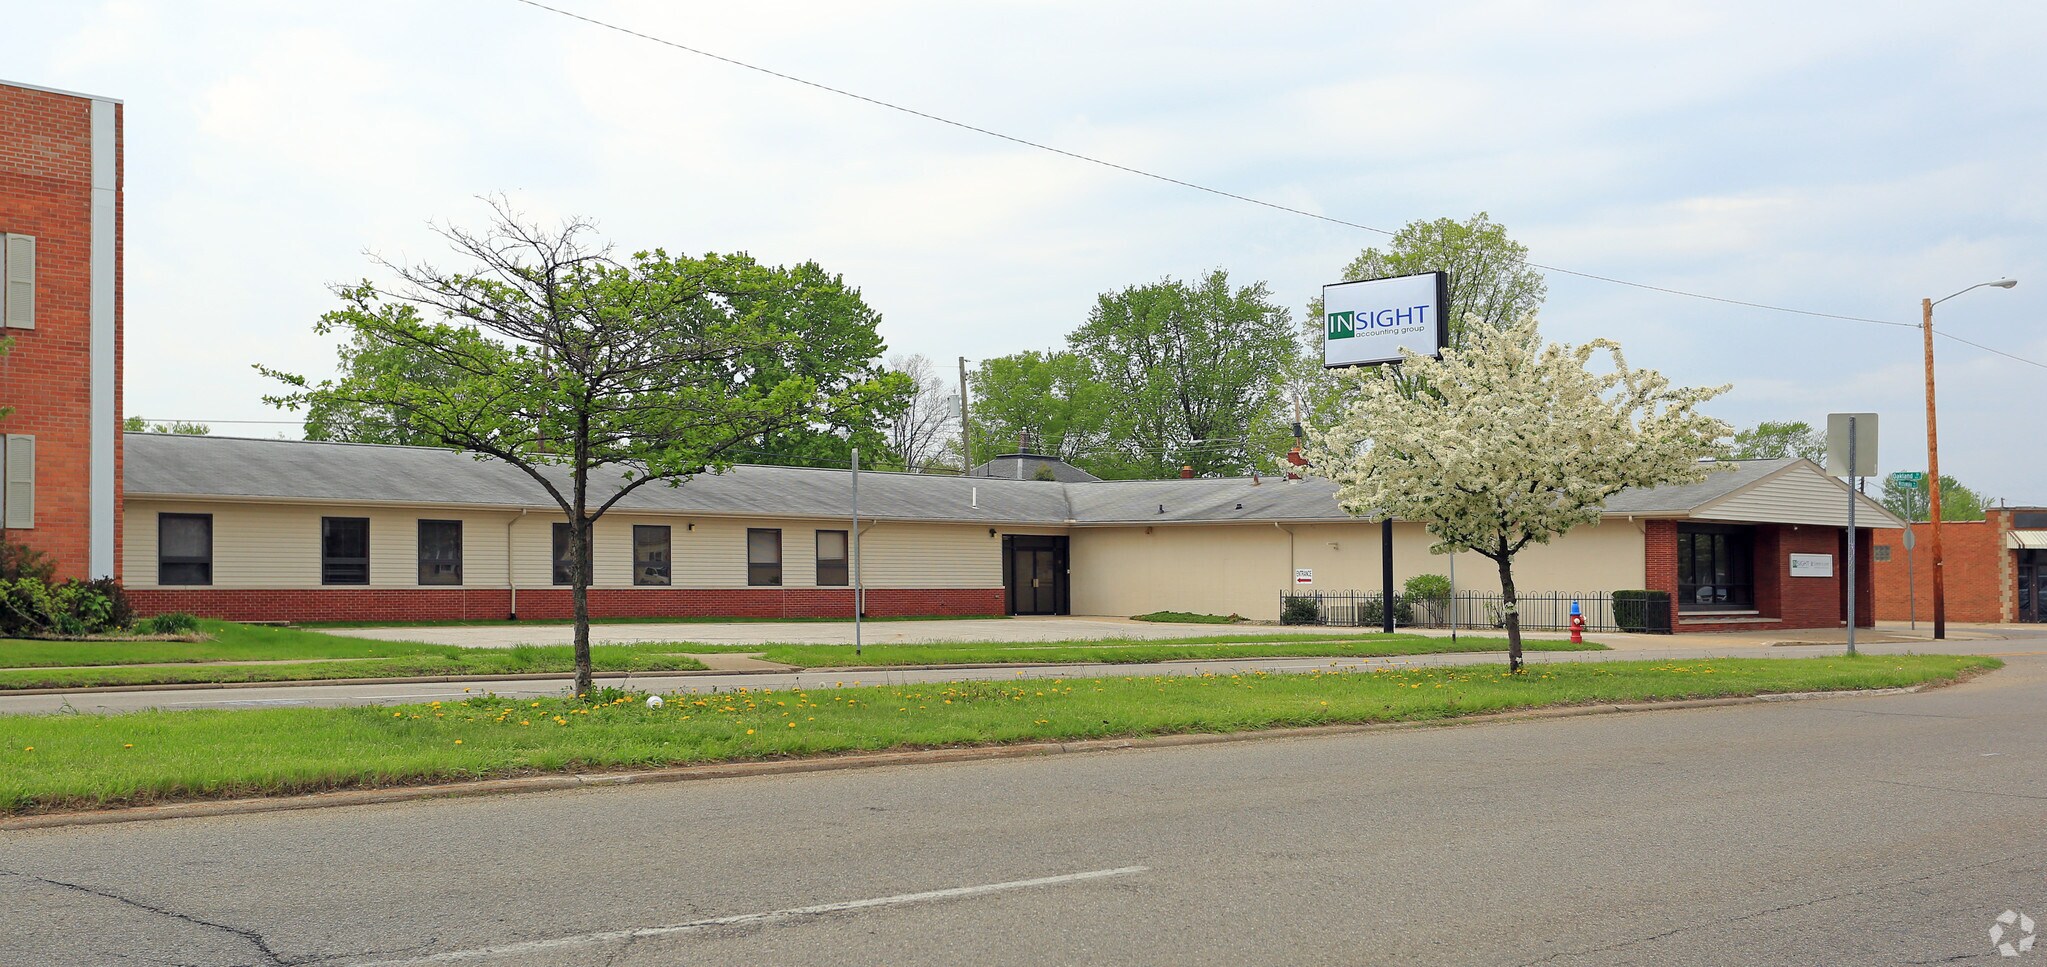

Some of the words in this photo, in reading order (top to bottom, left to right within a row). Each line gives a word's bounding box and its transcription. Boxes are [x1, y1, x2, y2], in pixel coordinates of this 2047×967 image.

[1329, 305, 1430, 335] INSIGHT
[1355, 327, 1399, 338] accounting
[1401, 326, 1425, 335] group
[1893, 472, 1913, 480] Oakland
